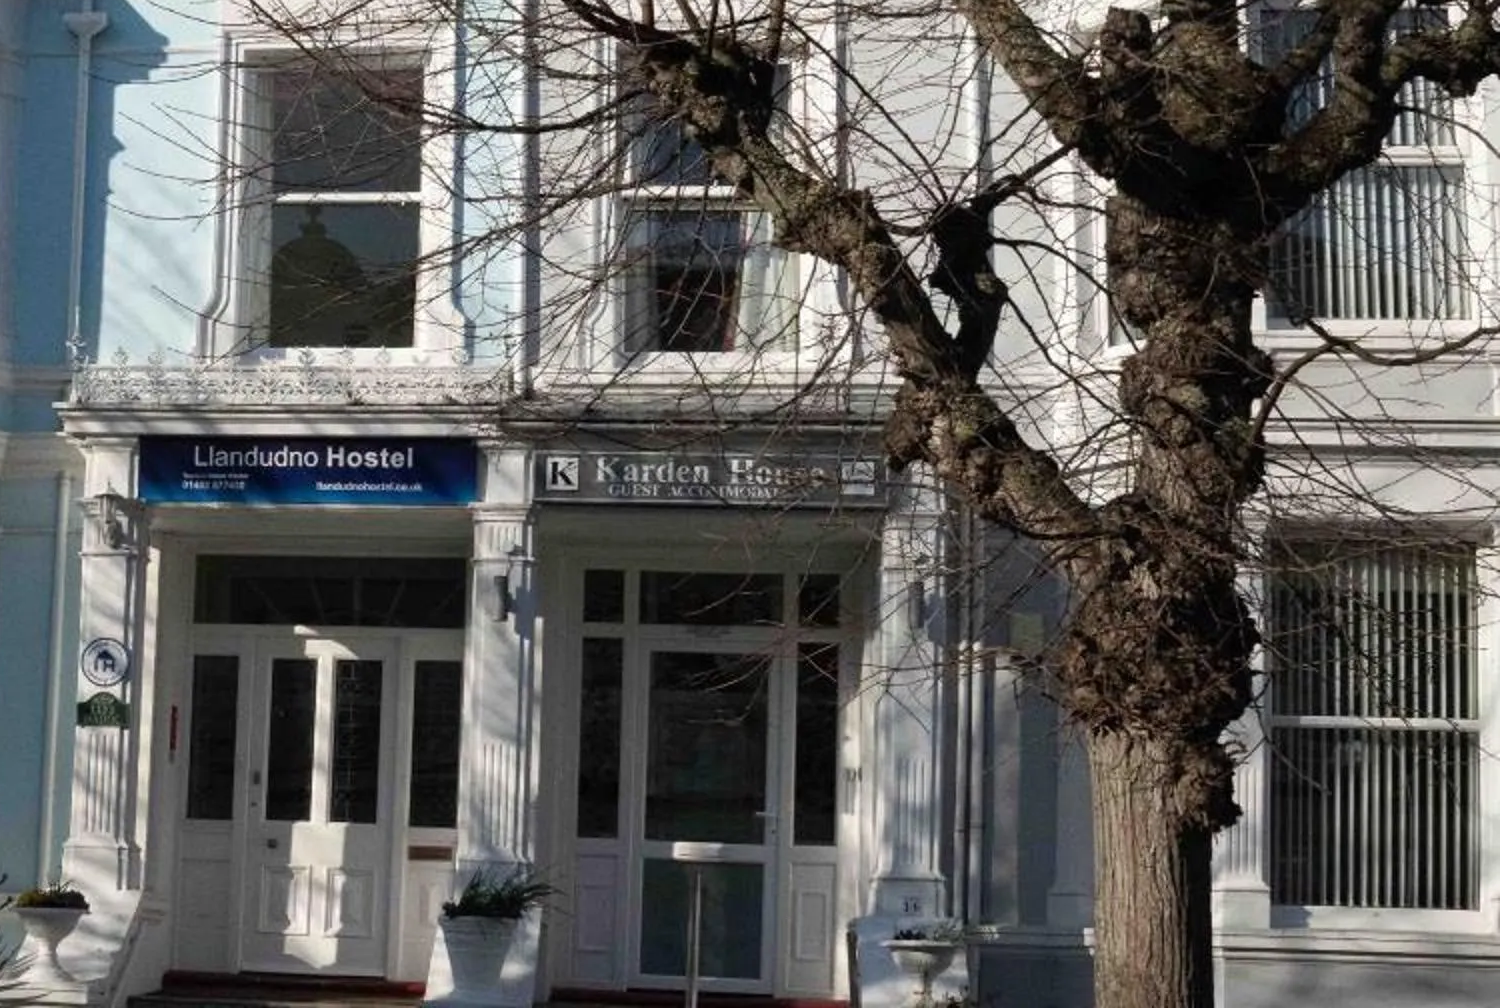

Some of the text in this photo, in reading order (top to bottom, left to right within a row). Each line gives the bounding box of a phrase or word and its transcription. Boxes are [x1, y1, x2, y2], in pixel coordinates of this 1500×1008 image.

[194, 445, 414, 468] Llandudno Hostel
[551, 461, 576, 485] K
[596, 457, 709, 483] Karden
[608, 483, 659, 497] GUEST
